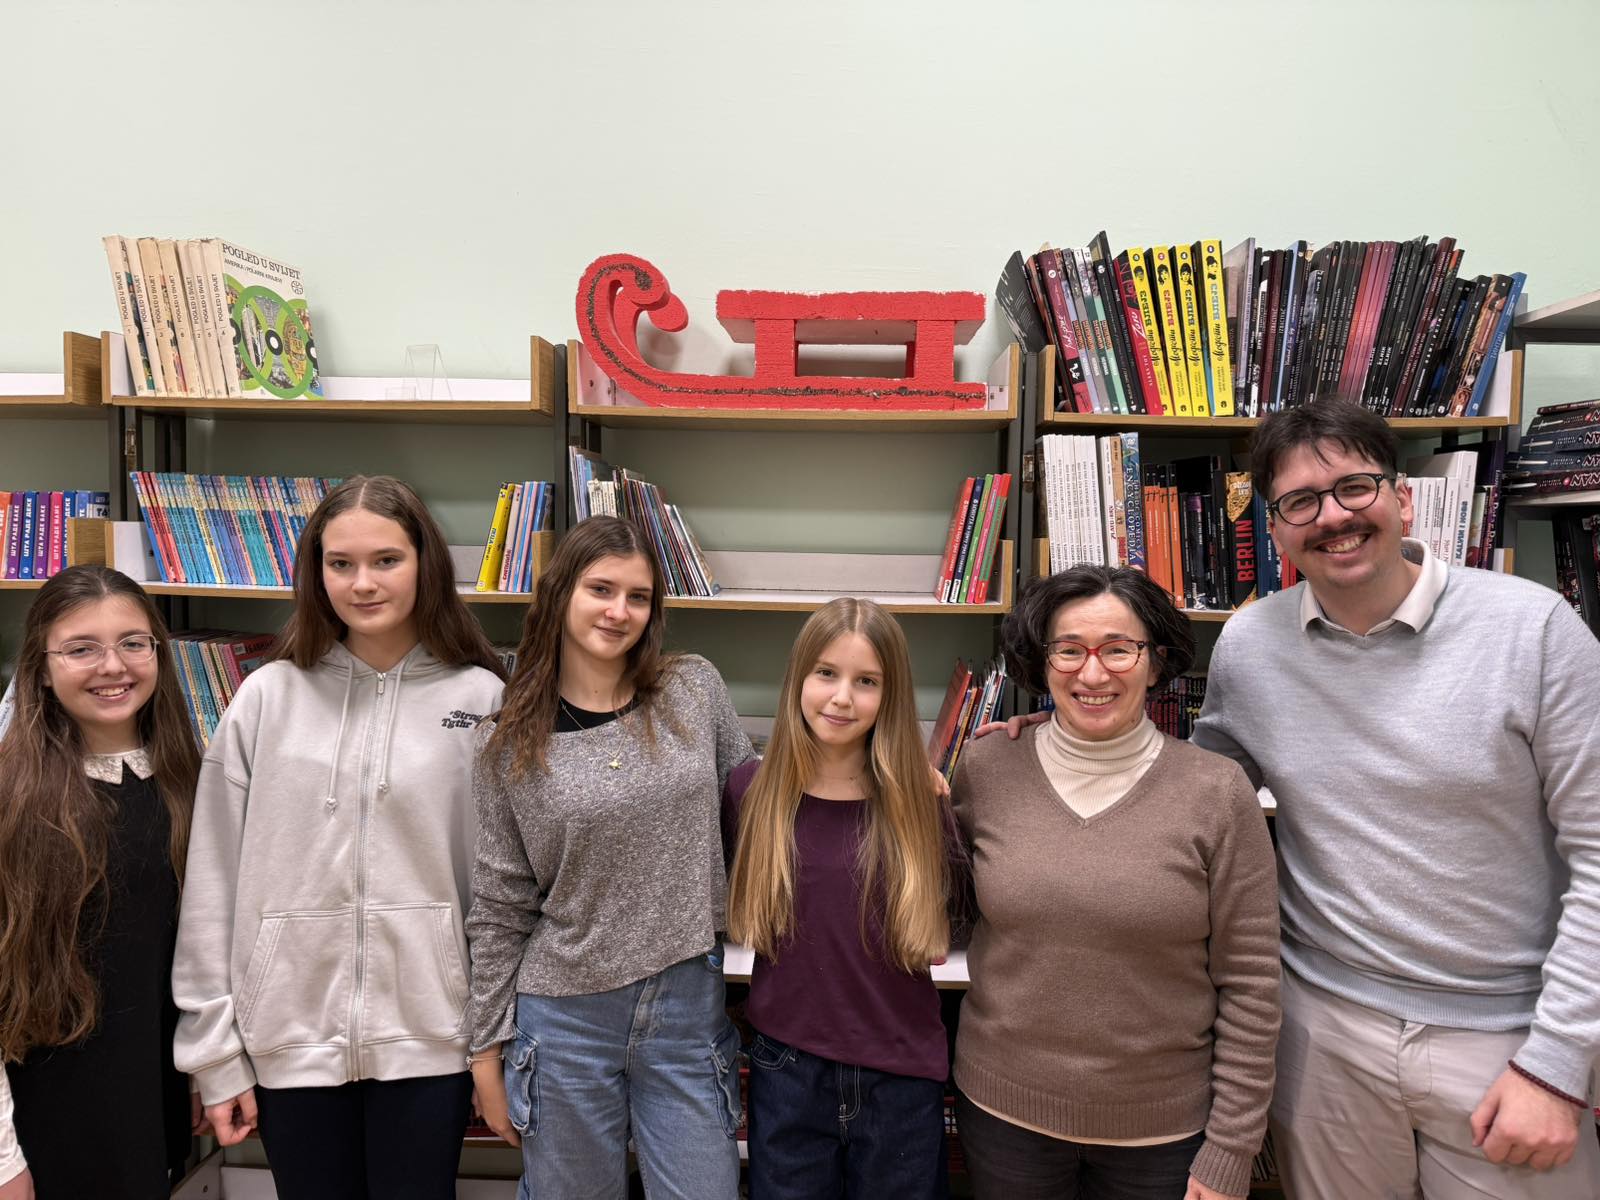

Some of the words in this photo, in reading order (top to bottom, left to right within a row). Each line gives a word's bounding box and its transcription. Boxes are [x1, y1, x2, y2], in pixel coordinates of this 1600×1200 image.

[222, 243, 260, 266] POGLED
[260, 258, 268, 269] U
[268, 261, 301, 280] SVIJET
[120, 296, 129, 320] POGLED
[139, 300, 148, 323] POGLED
[174, 300, 182, 323] POGLED
[190, 302, 199, 325] POGLED
[201, 300, 209, 324] POGLED
[216, 298, 224, 322] POGLED
[1127, 467, 1136, 560] ENCYCLOPEDIA
[1235, 519, 1255, 583] BERLIN
[1456, 530, 1465, 560] KALVIN
[441, 718, 473, 729] Tgthr
